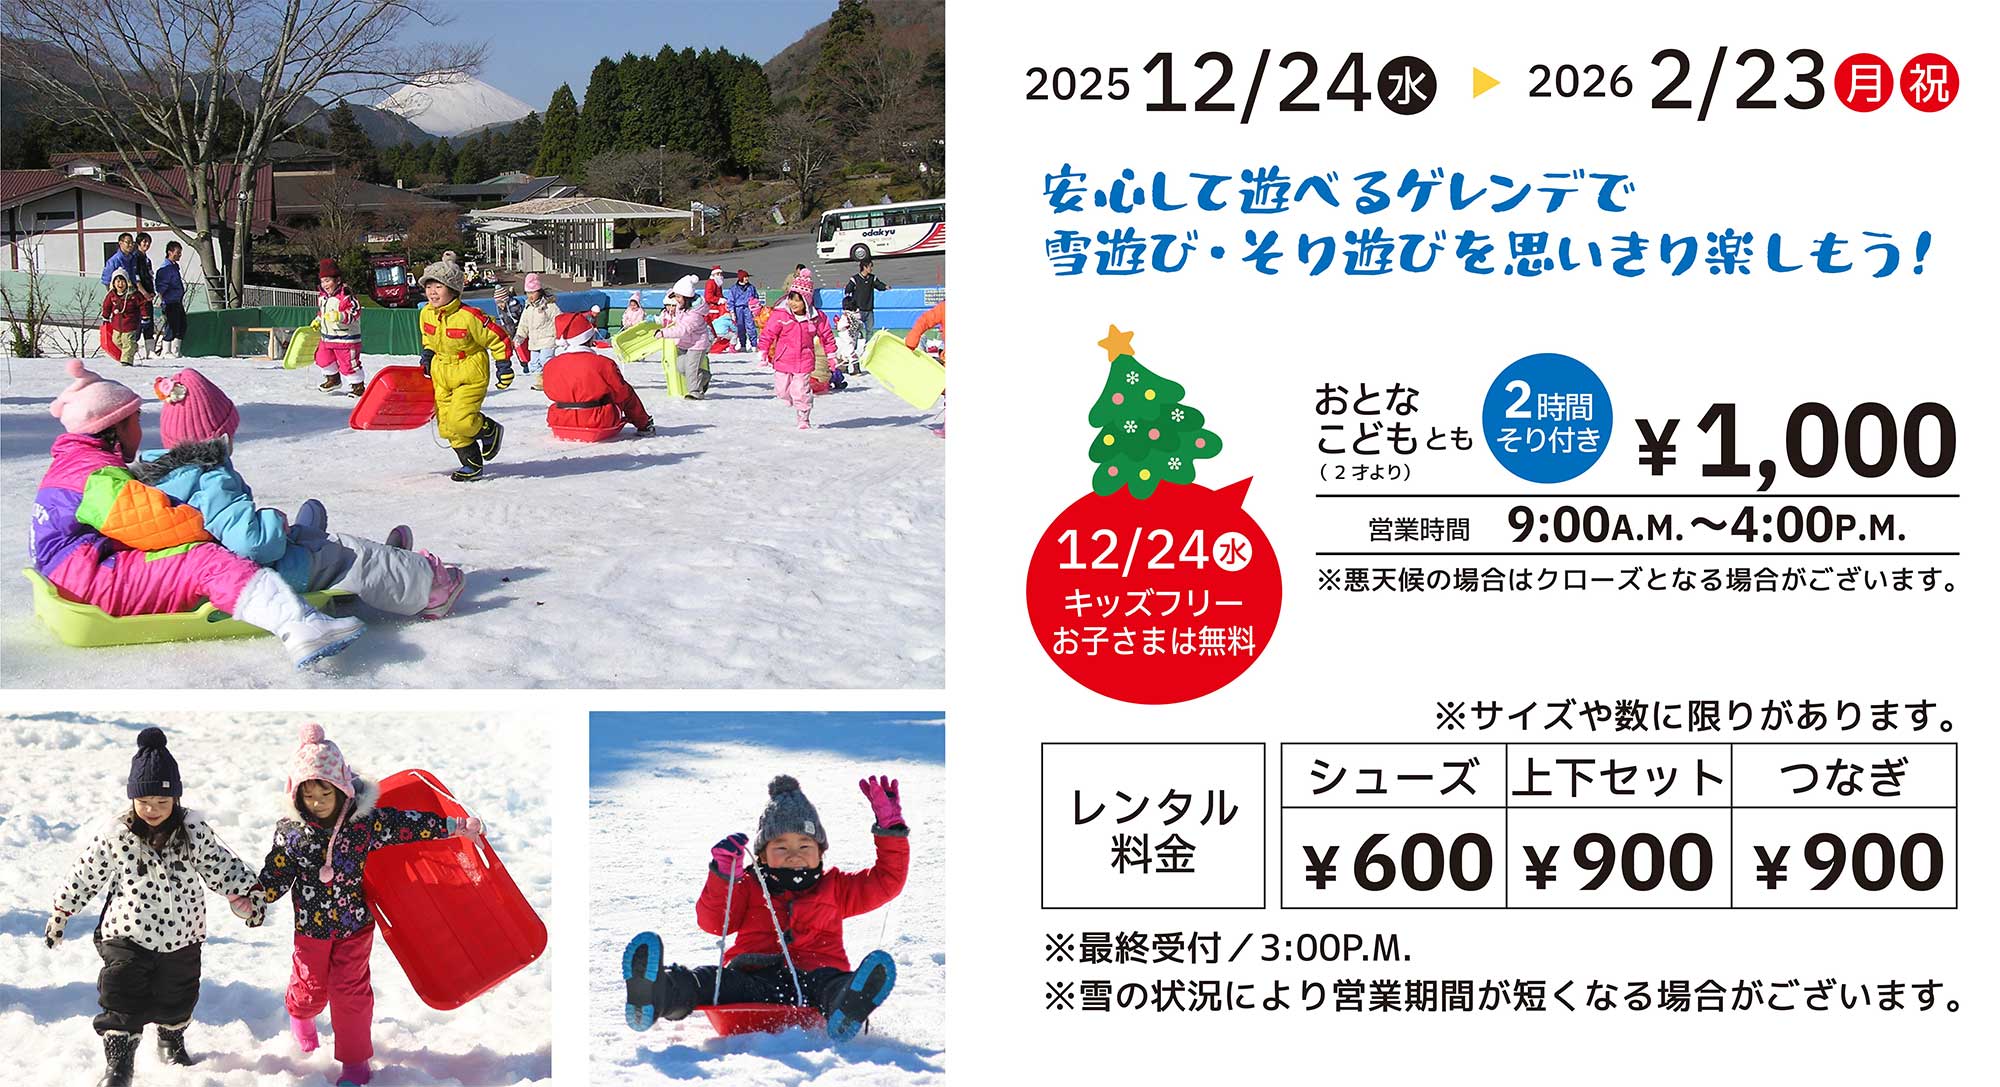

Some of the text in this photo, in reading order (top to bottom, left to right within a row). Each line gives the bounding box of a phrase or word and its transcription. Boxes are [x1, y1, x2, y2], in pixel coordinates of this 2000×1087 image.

[1026, 49, 1427, 124] 2025 12/24 水
[1529, 46, 1950, 121] 2026 2/23 月 祝
[1043, 163, 1635, 214] 安心して遊べるゲレンデで
[862, 228, 896, 238] odakyu
[1046, 227, 1931, 278] 雪遊び・そり遊びを思いきり楽しもう！
[1316, 383, 1419, 415] おとな
[1506, 380, 1592, 421] 2時間
[1496, 427, 1600, 454] そり付き
[1370, 517, 1469, 541] 営業時間
[1058, 527, 1248, 577] 12/24 水
[1319, 567, 1954, 592] ※悪天候の場合はクローズとなる場合がございます。
[1066, 588, 1242, 617] キッズフリー
[1053, 625, 1256, 658] お子さまは無料
[1437, 698, 1952, 732] ※サイズや数に限りがあります。
[1311, 757, 1480, 795] シューズ
[1512, 758, 1722, 797] 上下セット
[1781, 757, 1908, 796] つなぎ
[1075, 789, 1238, 825] レンタル
[1111, 834, 1196, 873] 料金
[1046, 978, 1959, 1012] ※雪の状況により営業期間が短くなる場合がございます。
